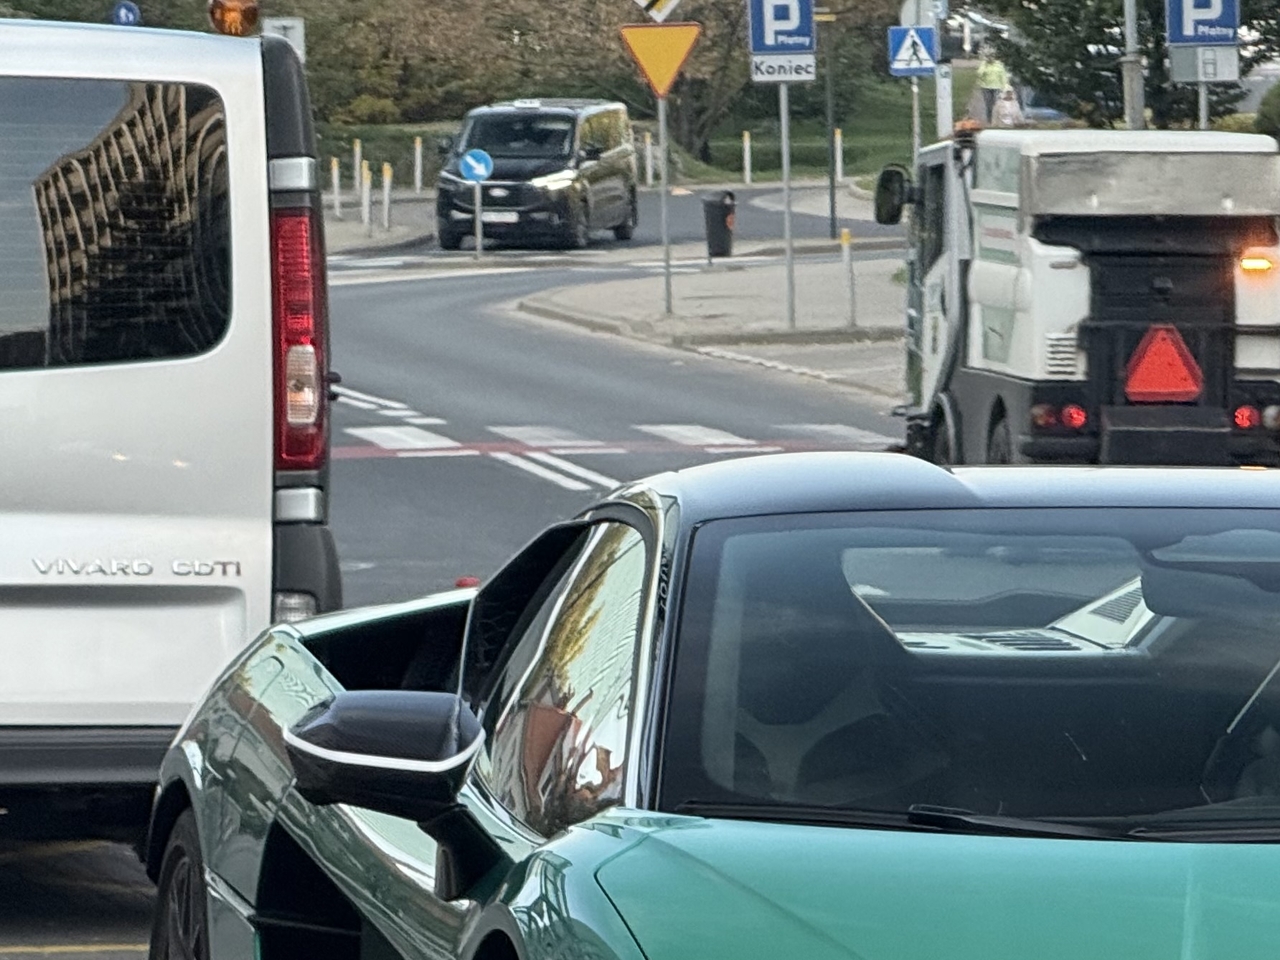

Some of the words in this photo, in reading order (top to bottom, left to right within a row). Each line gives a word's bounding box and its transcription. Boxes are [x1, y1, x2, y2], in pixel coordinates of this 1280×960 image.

[754, 60, 814, 76] Koniec
[31, 558, 154, 577] VIVARO
[171, 558, 242, 577] CDTI
